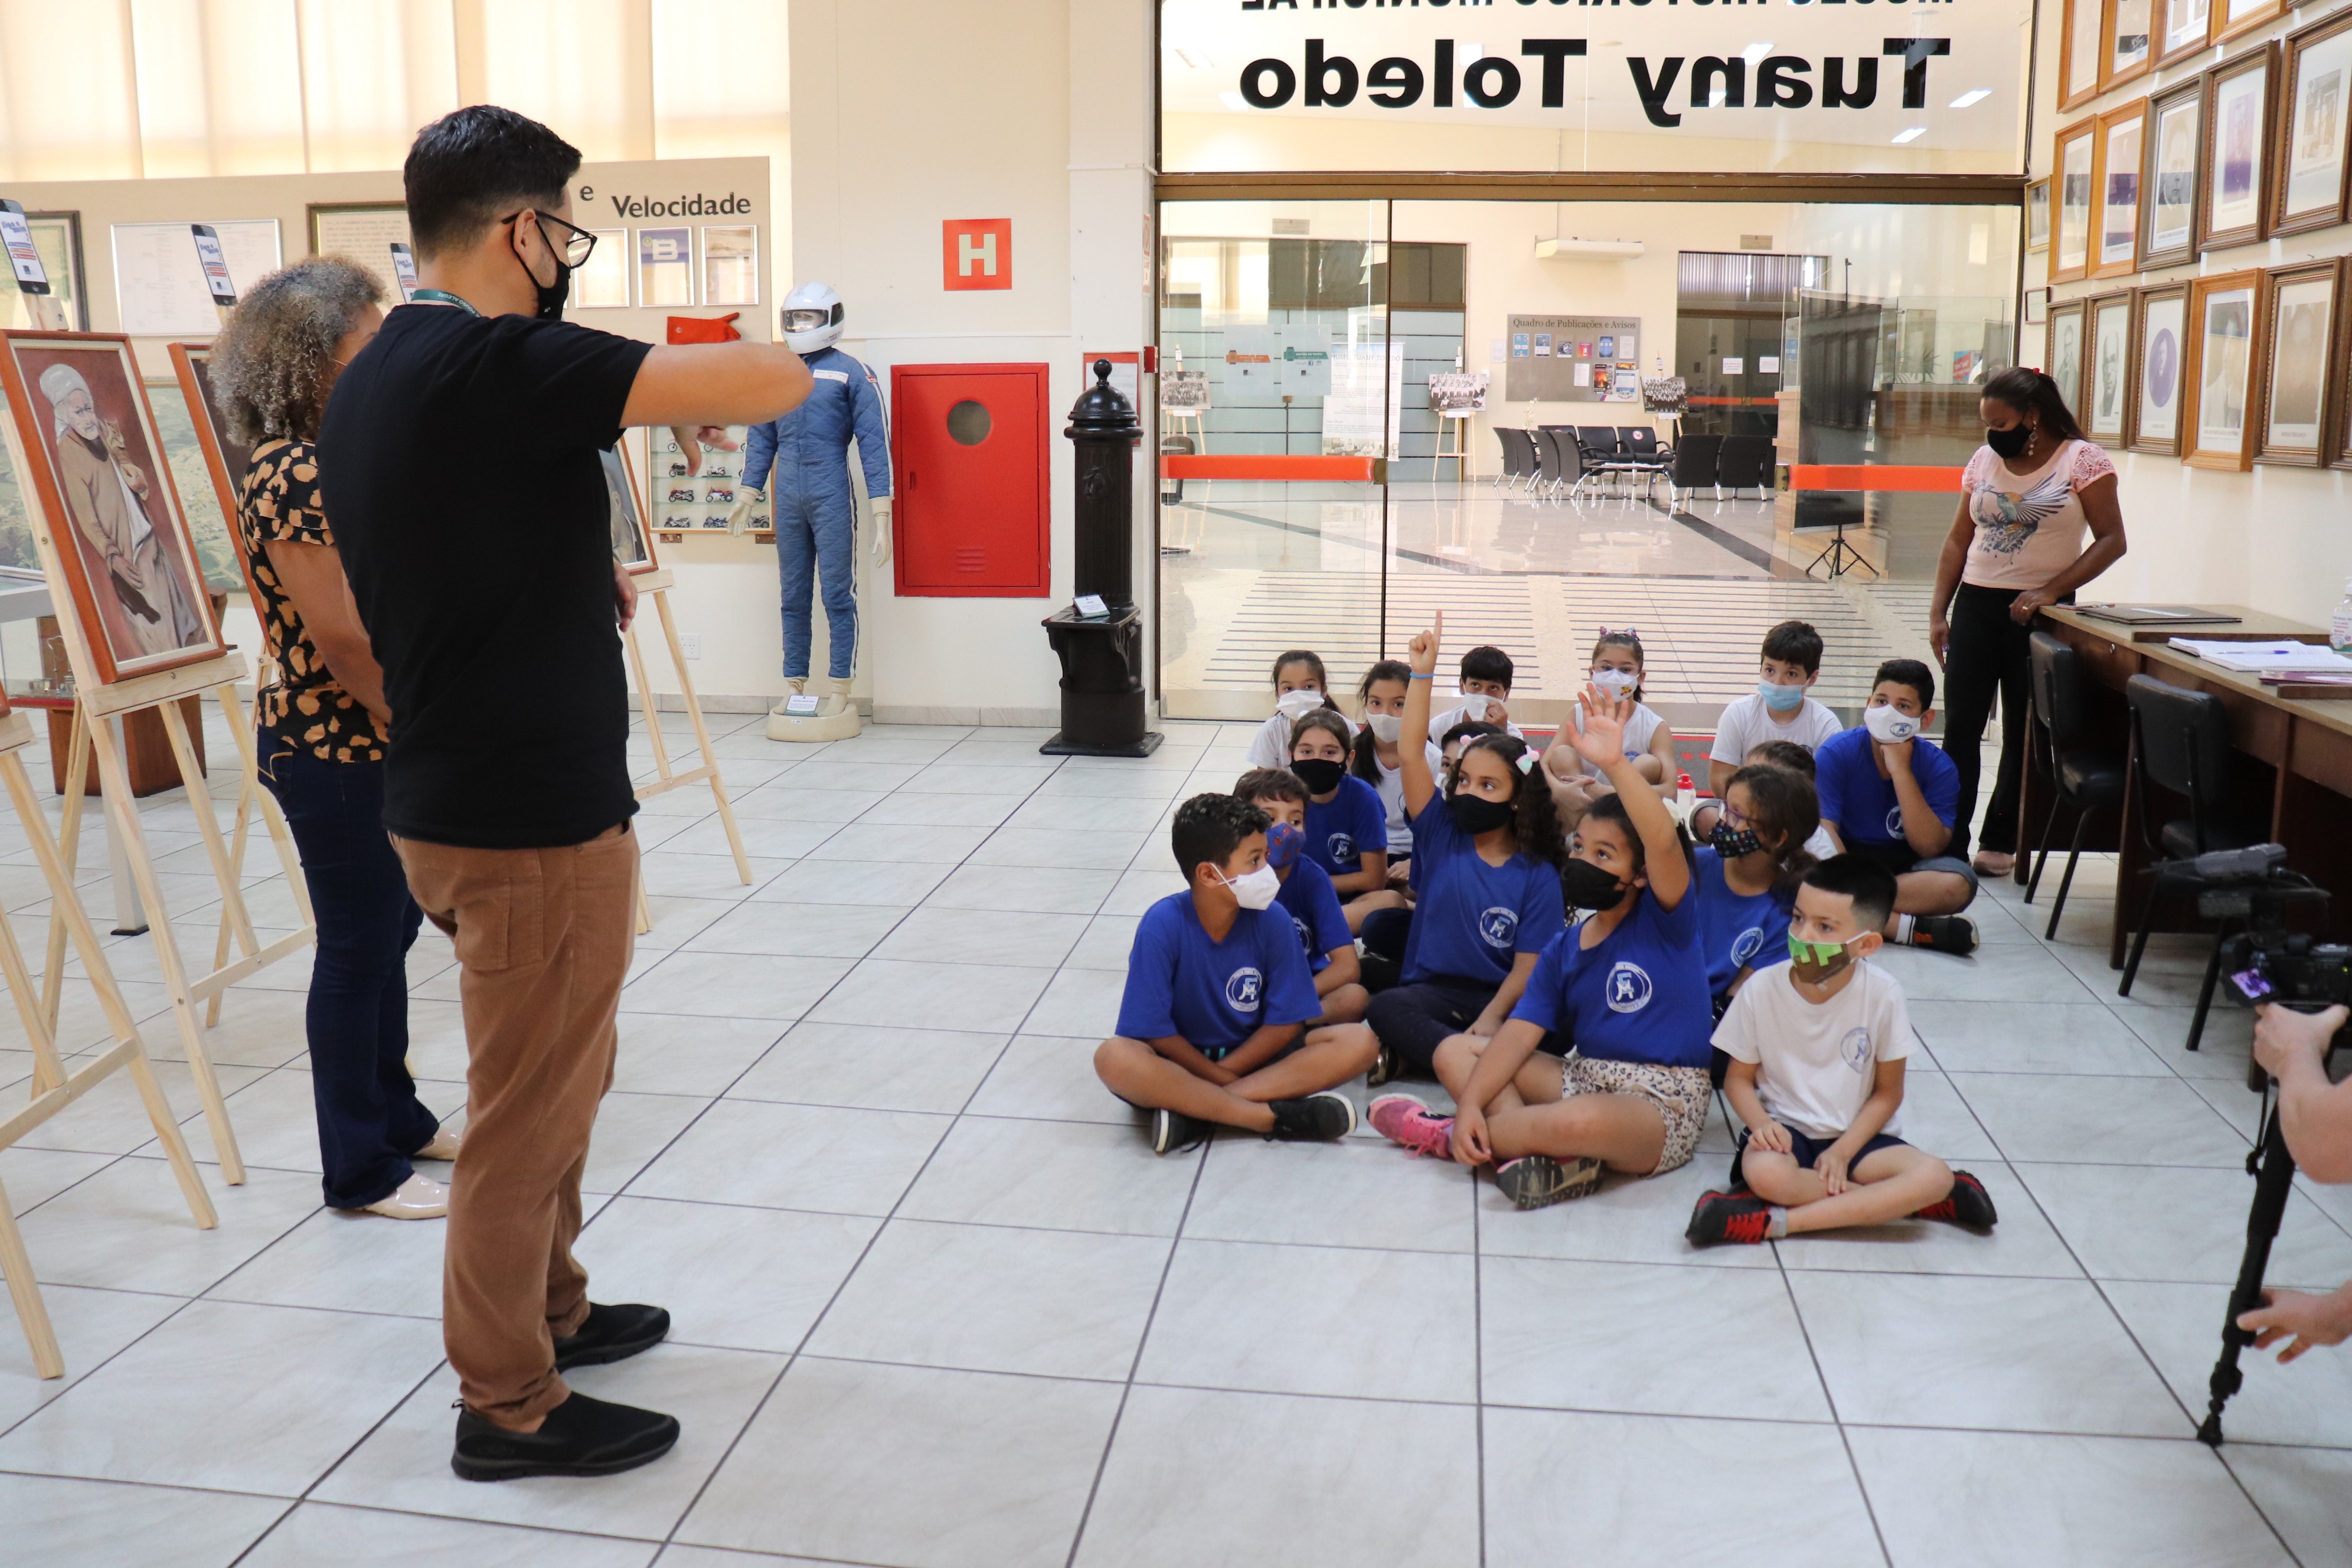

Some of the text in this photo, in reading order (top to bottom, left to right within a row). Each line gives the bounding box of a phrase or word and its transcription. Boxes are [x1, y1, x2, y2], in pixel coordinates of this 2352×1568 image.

[580, 185, 751, 218] e Velocidade
[958, 233, 997, 276] H
[1513, 318, 1543, 328] Quadro
[1546, 319, 1555, 328] de
[1557, 319, 1603, 330] Publicações
[1611, 321, 1636, 329] Avisos
